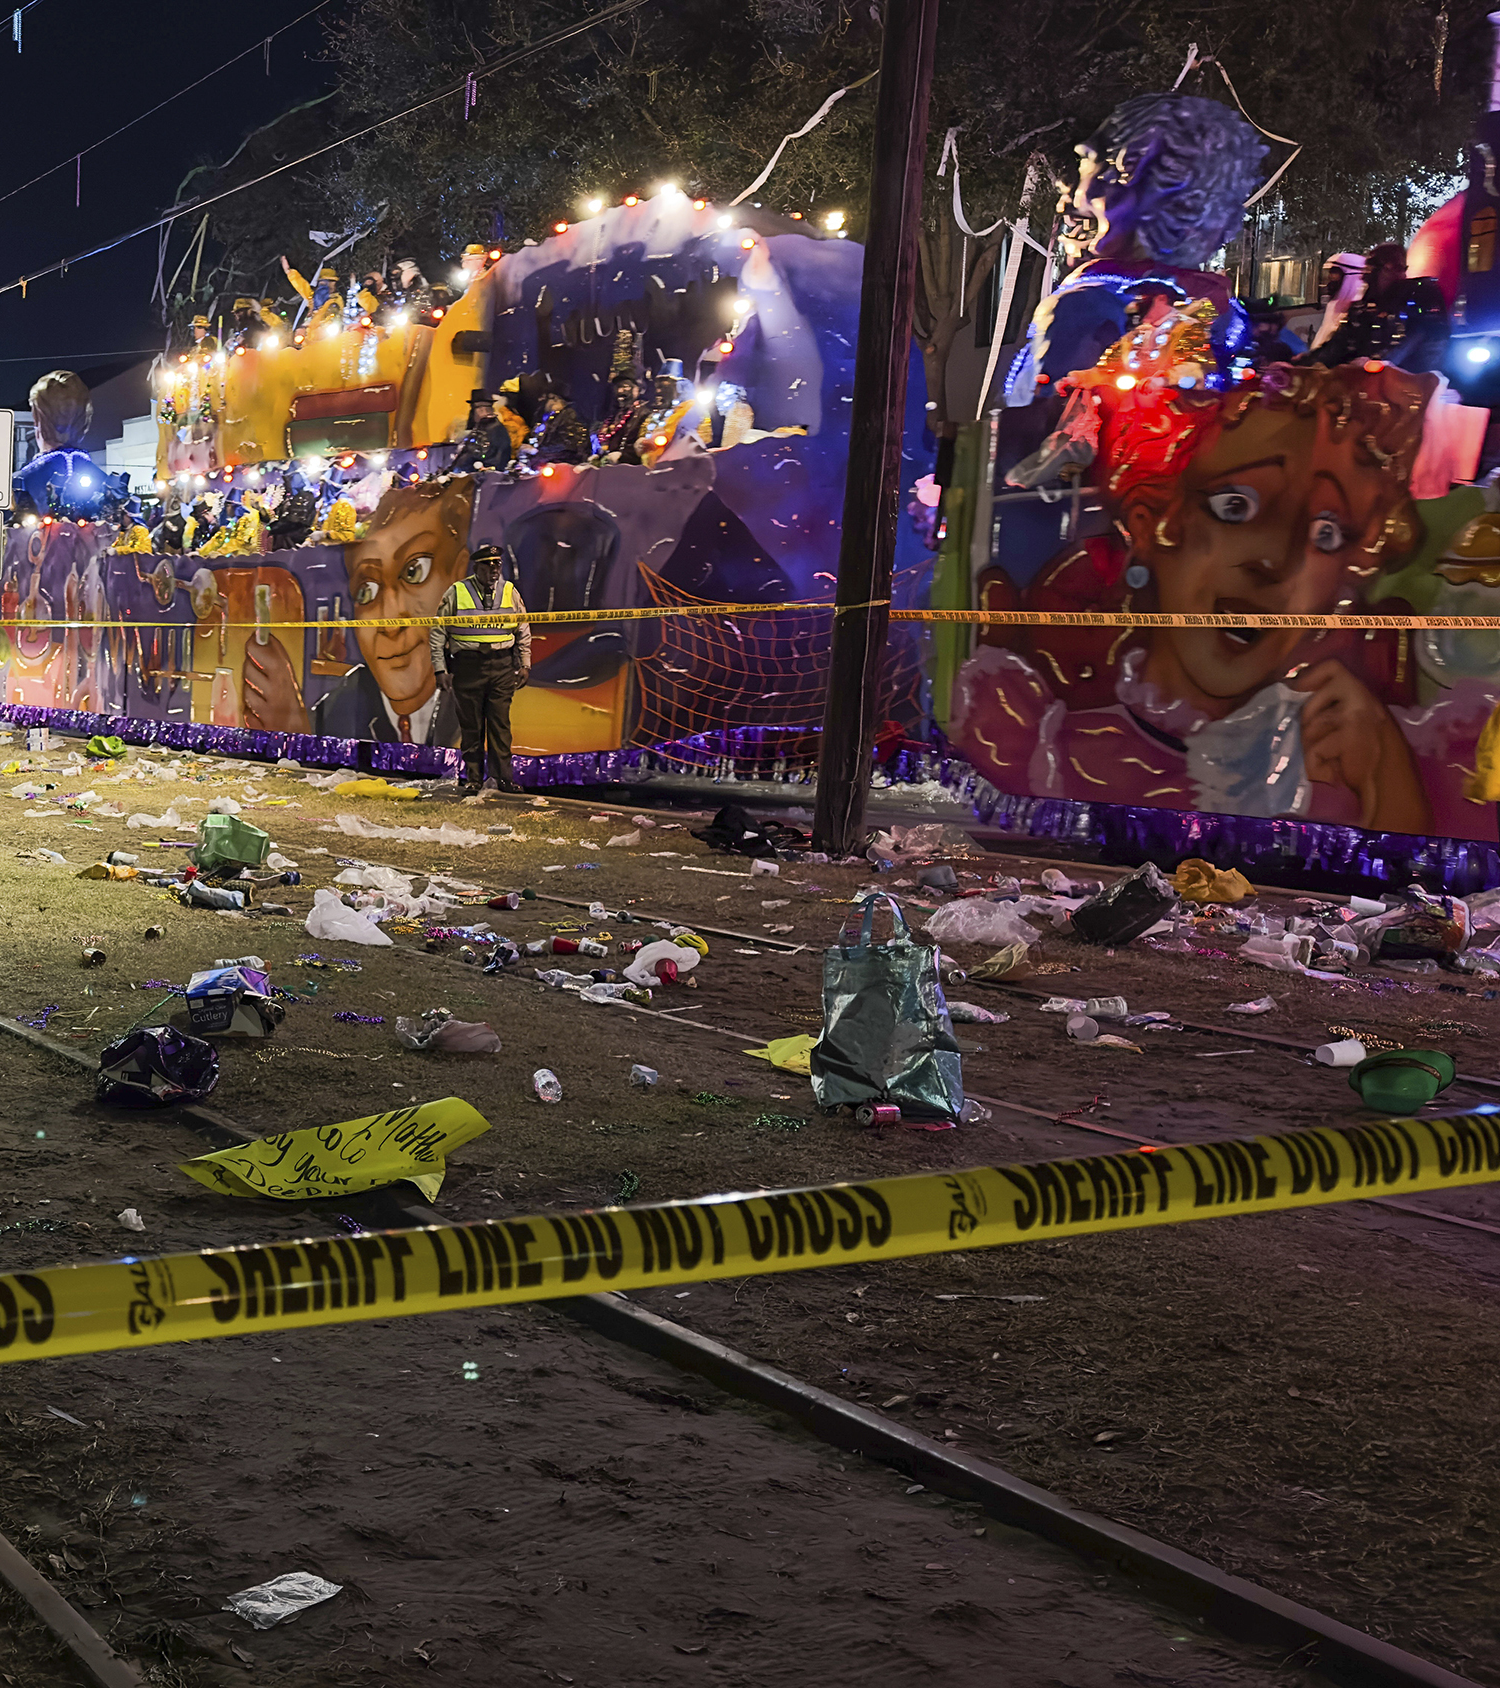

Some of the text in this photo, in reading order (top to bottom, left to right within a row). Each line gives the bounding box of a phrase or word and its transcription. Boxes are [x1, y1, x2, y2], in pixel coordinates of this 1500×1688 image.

[192, 1010, 228, 1023] Cutlery
[996, 1152, 1174, 1231] SHERIFF
[1174, 1140, 1278, 1208] LINE
[1270, 1130, 1340, 1195] DO
[1336, 1123, 1420, 1188] NOT
[201, 1235, 415, 1324] SHERIFF
[425, 1222, 543, 1298] LINE
[550, 1212, 623, 1282] DO
[628, 1204, 725, 1275] NOT
[733, 1185, 892, 1262] CROSS
